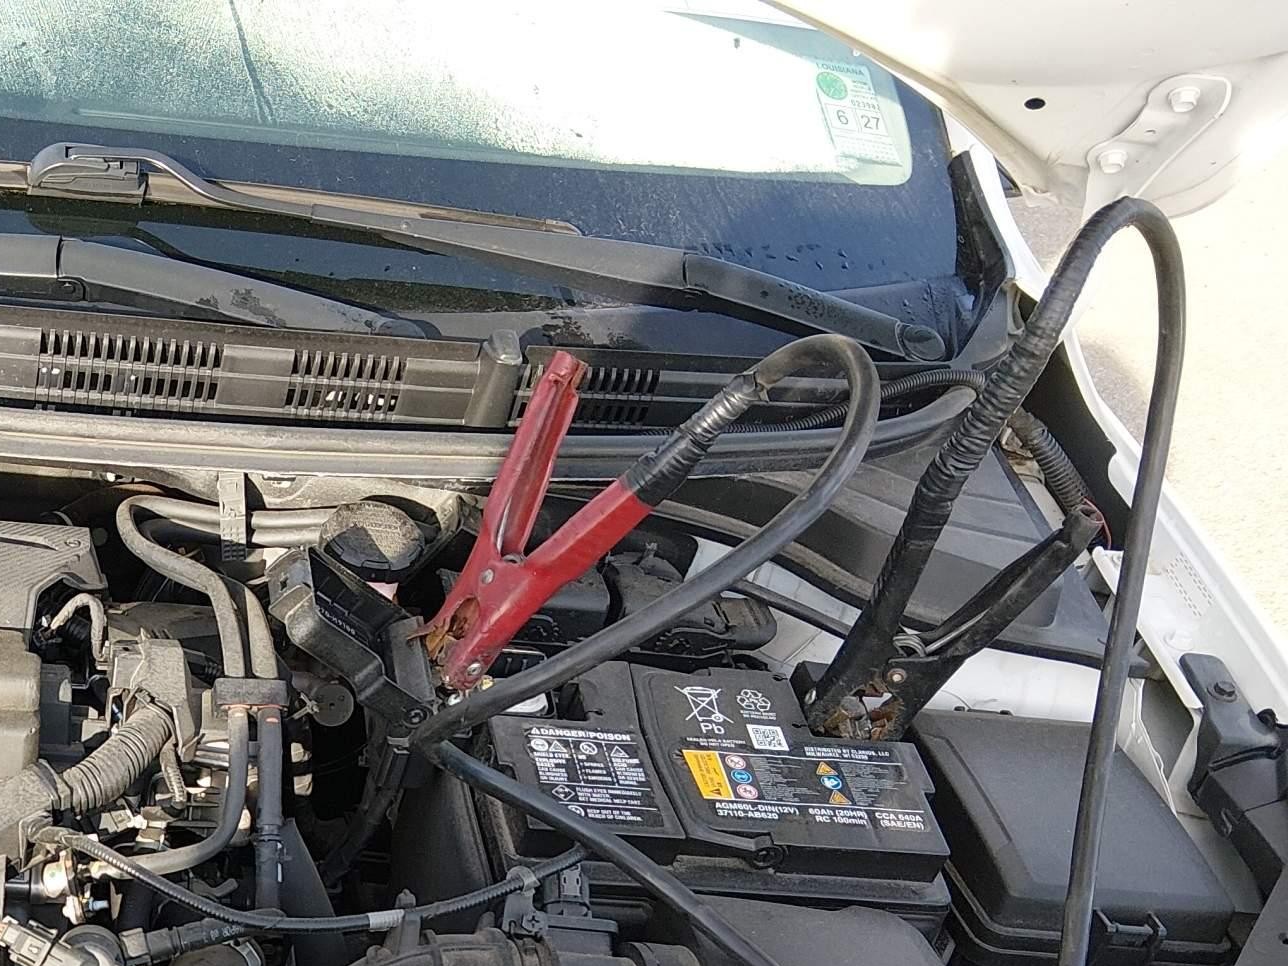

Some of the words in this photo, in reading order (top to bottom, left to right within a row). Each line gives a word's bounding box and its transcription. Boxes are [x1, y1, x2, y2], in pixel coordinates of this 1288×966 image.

[816, 62, 865, 76] LOUISIANA
[836, 109, 849, 125] 6
[860, 114, 881, 130] 27
[700, 722, 725, 734] Pb
[808, 807, 834, 817] 60Ah
[835, 808, 868, 819] (20HR)
[875, 811, 897, 821] CCA
[815, 815, 830, 823] RC
[833, 816, 867, 826] 100min
[880, 819, 925, 830] (SAE/EN)
